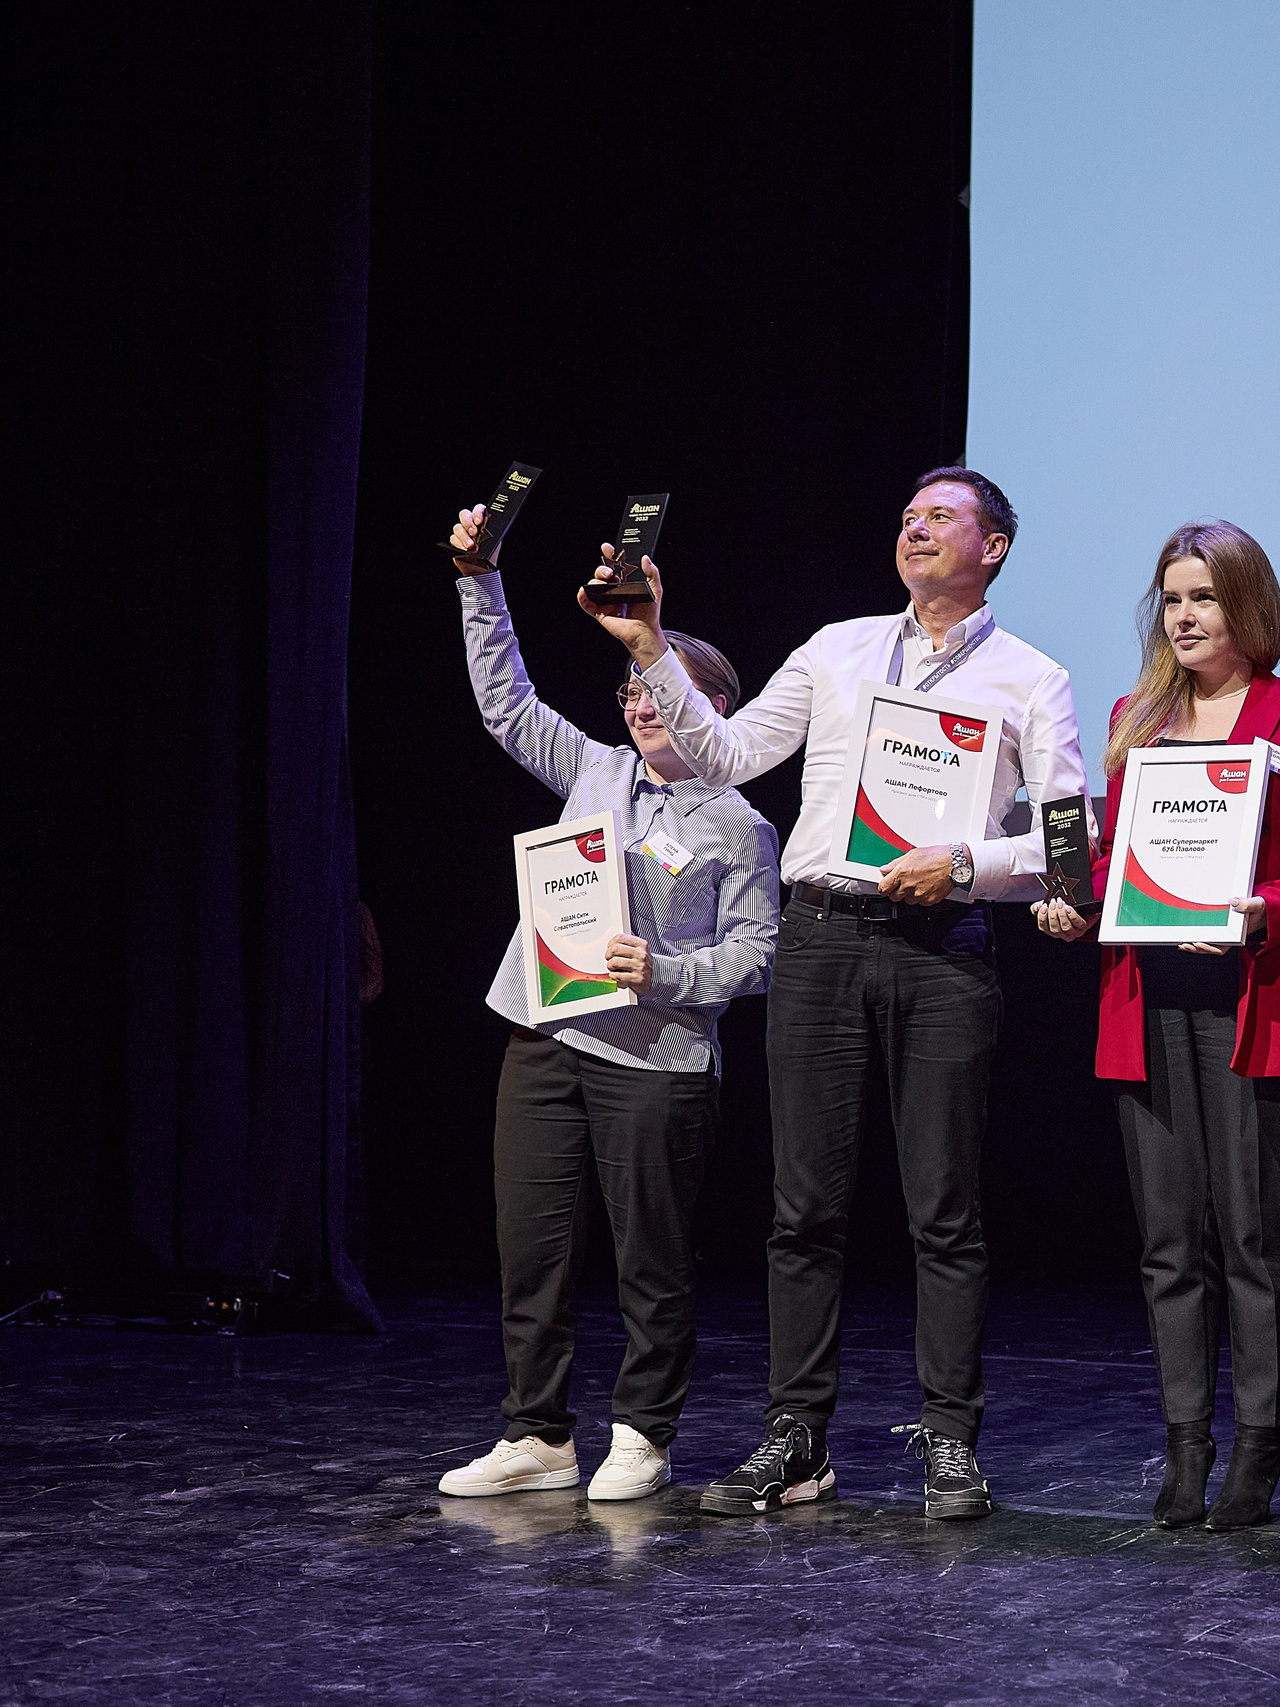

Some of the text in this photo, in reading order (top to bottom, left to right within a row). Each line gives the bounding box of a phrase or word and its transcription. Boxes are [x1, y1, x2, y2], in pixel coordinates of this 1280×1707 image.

[882, 738, 961, 768] ГРАМОТА
[1219, 768, 1247, 778] Ашан
[884, 778, 908, 788] АШАН
[908, 783, 948, 797] Лефортово
[1152, 799, 1228, 814] ГРАМОТА
[1048, 808, 1080, 822] Ашан
[1172, 838, 1219, 846] Супермаркет
[544, 870, 599, 895] ГРАМОТА
